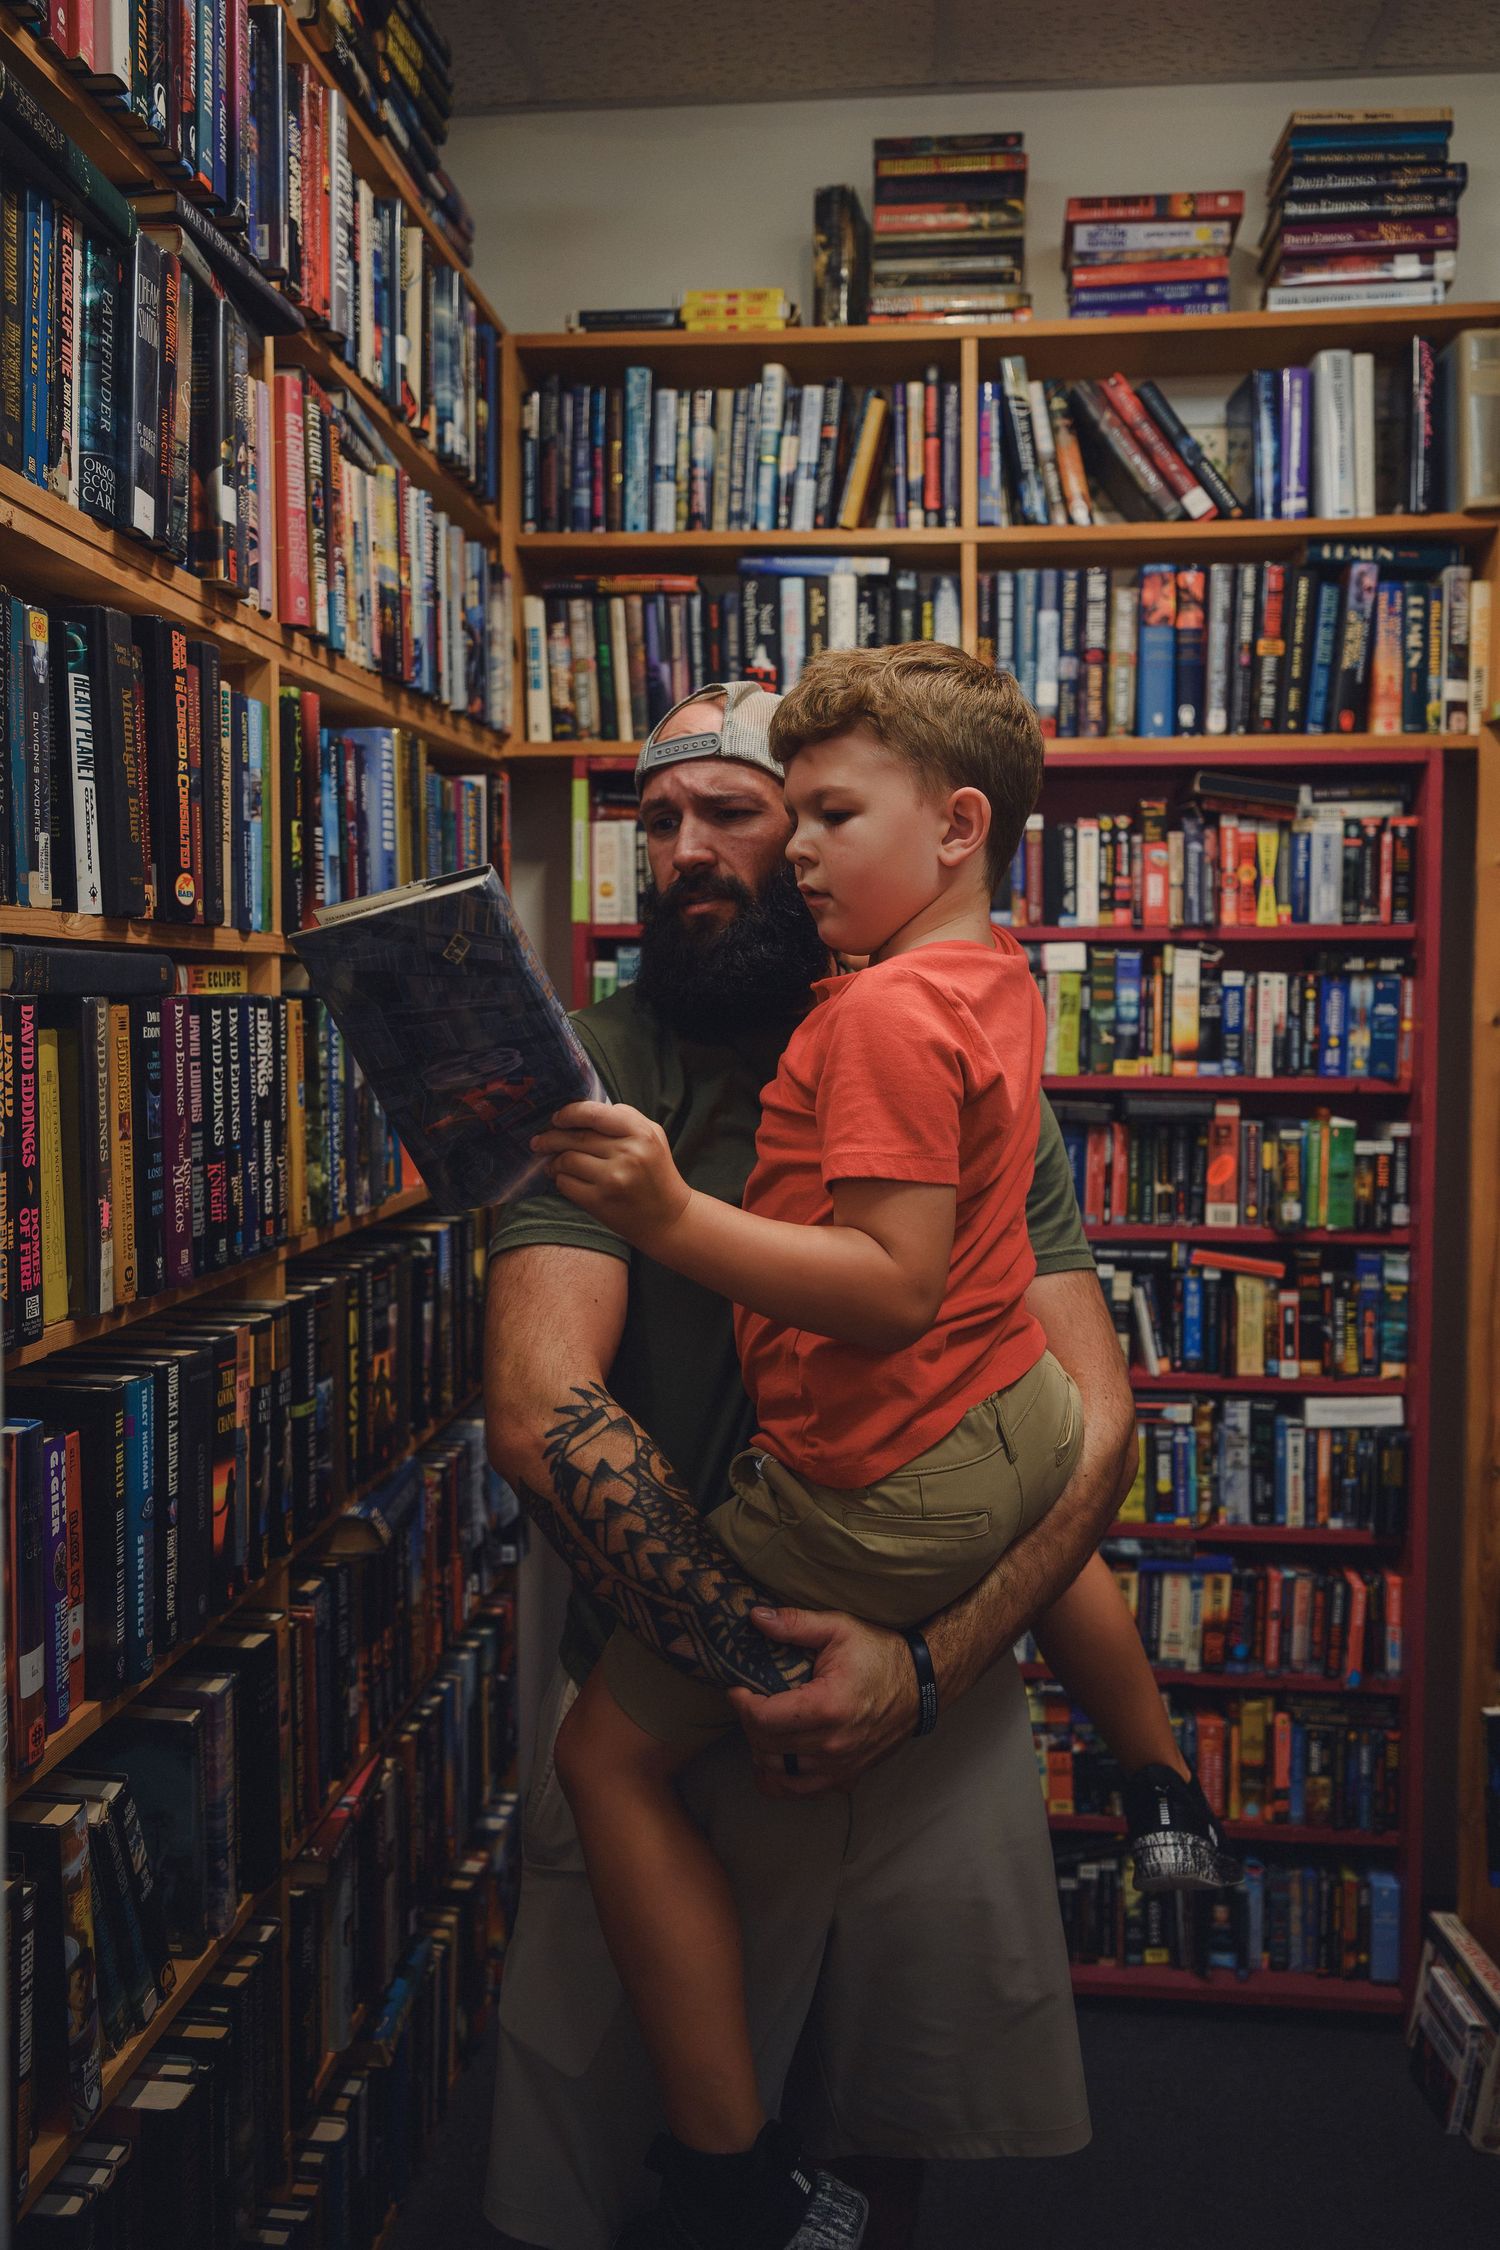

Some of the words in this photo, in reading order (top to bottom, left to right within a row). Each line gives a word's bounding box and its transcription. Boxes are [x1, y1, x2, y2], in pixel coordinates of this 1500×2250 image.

[61, 214, 73, 247] THE
[4, 241, 17, 305] BROOKS
[61, 244, 73, 317] CRUCIBLE
[164, 274, 177, 303] JACK
[61, 315, 72, 340] OF
[164, 304, 177, 365] CAMPBELL
[61, 337, 73, 380] TIME
[100, 287, 114, 434] PATHFINDER
[63, 377, 72, 407] JOHN
[160, 407, 169, 476] INVINCIBLE
[171, 629, 181, 670] COOK
[179, 633, 187, 670] RICK
[73, 676, 92, 726] HEAVY
[135, 704, 143, 754] STORM
[176, 694, 188, 759] CURSED
[221, 690, 230, 738] BEASTS
[76, 728, 95, 784] PLANET
[121, 688, 139, 789] Midnight
[188, 726, 196, 748] SEA
[178, 760, 187, 771] &
[33, 778, 41, 842] FAVORITES
[84, 786, 94, 875] CLEMENT
[127, 796, 142, 844] Blue
[177, 773, 191, 869] CONSULTED
[208, 970, 241, 989] ECLIPSE
[21, 1004, 35, 1070] DAVID
[96, 1006, 108, 1069] DAVID
[174, 1004, 184, 1049] DAVID
[189, 1014, 201, 1057] DAVID
[211, 1008, 223, 1064] DAVID
[228, 1007, 239, 1060] DAVID
[256, 1007, 270, 1098] EDDINGS
[4, 1034, 14, 1118] DAVID
[175, 1050, 187, 1117] EDDINGS
[189, 1061, 203, 1124] EDDINGS
[230, 1062, 241, 1142] EDDINGS
[21, 1073, 36, 1168] EDDINGS
[97, 1072, 109, 1163] EDDINGS
[212, 1065, 225, 1147] EDDINGS
[124, 1143, 132, 1172] THE
[263, 1120, 273, 1176] SHINING
[126, 1176, 134, 1221] ELDER
[172, 1165, 186, 1233] MURGOS
[183, 1157, 192, 1196] KING
[207, 1163, 223, 1223] KNIGHT
[263, 1178, 273, 1216] ONES
[19, 1207, 32, 1240] OF
[32, 1207, 41, 1287] DOMES
[127, 1223, 135, 1262] GODS
[0, 1253, 8, 1301] CITY
[20, 1242, 33, 1293] FIRE
[141, 1387, 149, 1426] TRACY
[167, 1363, 179, 1417] ROBERT
[114, 1408, 125, 1438] THE
[114, 1440, 125, 1499] TWELVE
[141, 1430, 150, 1490] HICKMAN
[167, 1432, 179, 1497] HEINLEIN
[69, 1510, 80, 1567] BLACK
[136, 1534, 145, 1639] SENTINELS
[54, 1602, 62, 1693] PLANETFALL
[20, 1929, 35, 1983] PETER
[18, 1998, 34, 2078] HAMILTON
